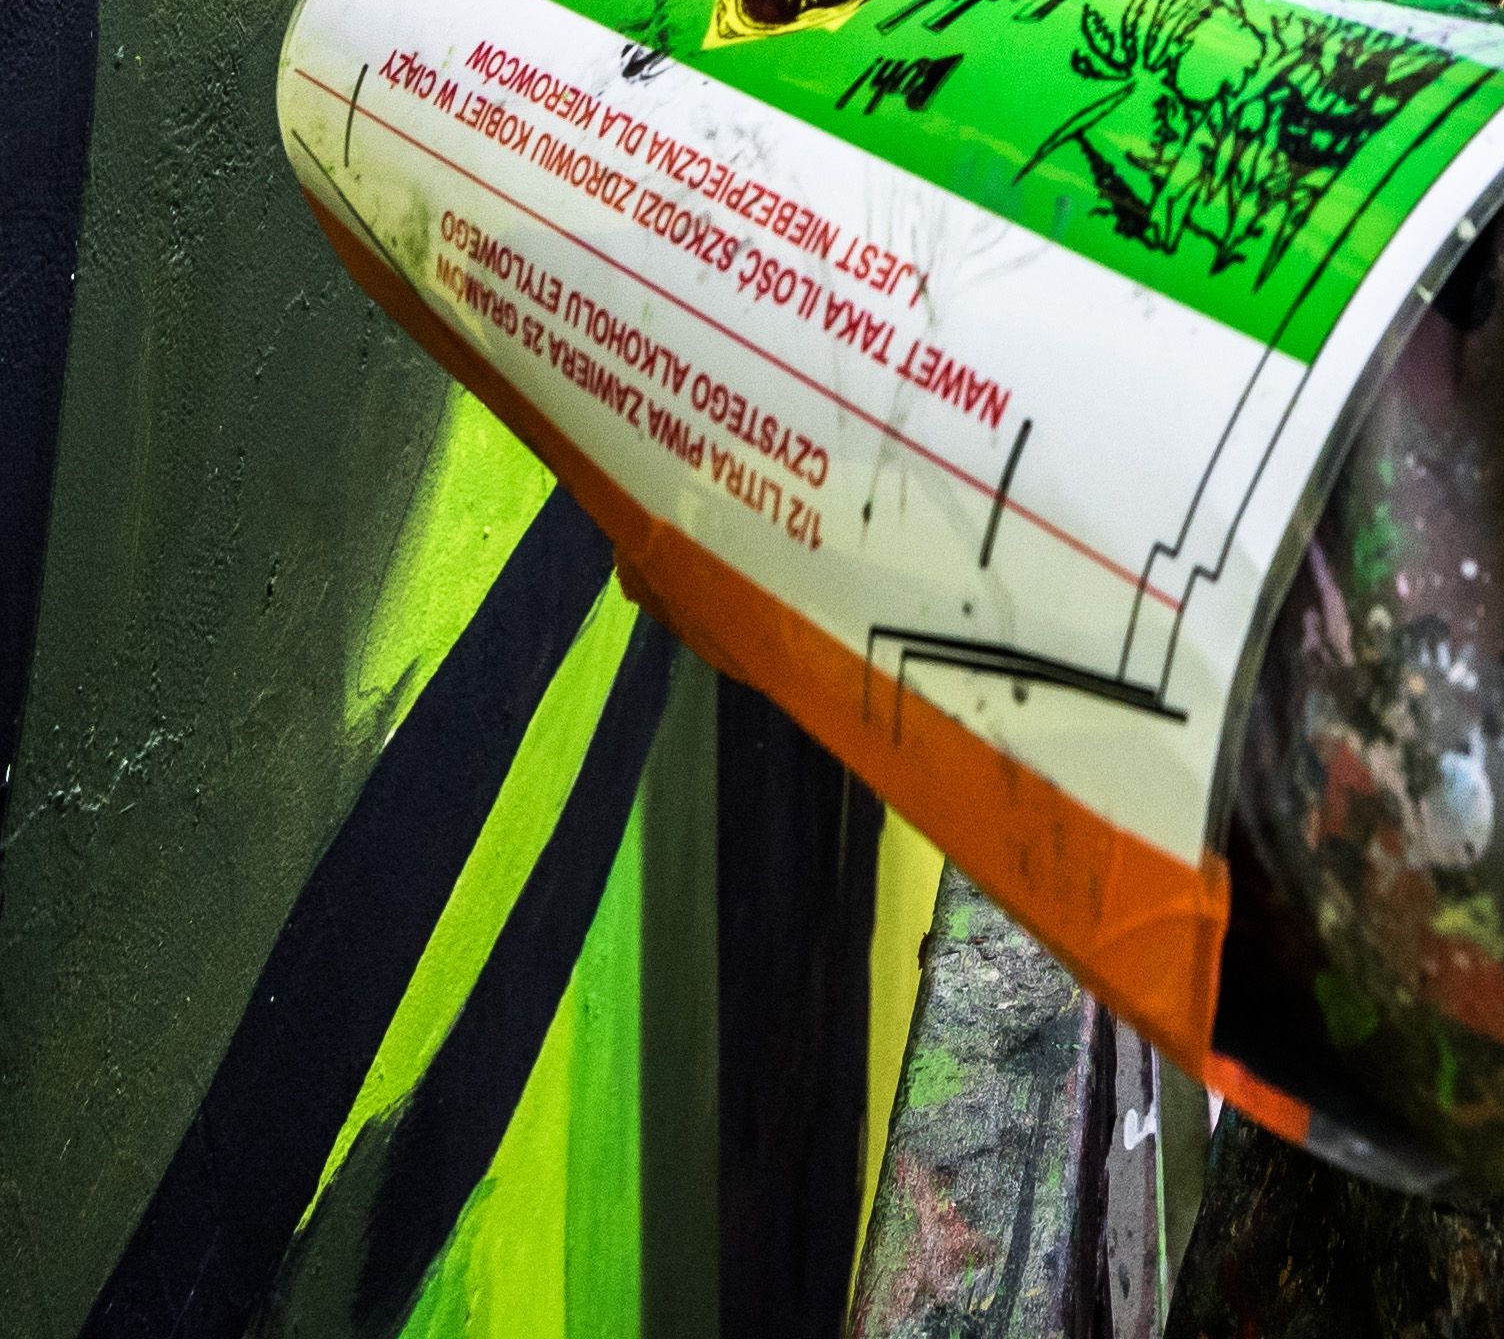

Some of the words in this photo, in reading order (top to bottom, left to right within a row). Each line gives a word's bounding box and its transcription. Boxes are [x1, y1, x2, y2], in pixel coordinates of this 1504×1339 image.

[378, 49, 437, 100] CIĄŻY
[433, 79, 458, 115] W
[465, 41, 601, 130] KIEROWCÓW
[454, 92, 534, 155] KOBIET
[598, 107, 648, 156] DLA
[530, 134, 637, 214] ZDROWIU
[644, 132, 840, 260] NIEBEZPIECZNA
[440, 210, 562, 315] ETYLOWEGO
[631, 190, 741, 273] SZKODZI
[835, 237, 914, 297] JEST
[435, 253, 518, 340] GRAMÓW
[735, 250, 822, 321] ILOŚĆ
[521, 318, 544, 358] 25
[564, 291, 690, 395] ALKOHOLU
[822, 291, 896, 367] TAKA
[547, 332, 644, 430] ZAWIERA
[896, 340, 1011, 429] NAWET
[647, 401, 705, 471] PIWA
[690, 373, 829, 489] CZYSTEGO
[710, 444, 783, 523] LITRA
[786, 496, 823, 552] 1/2
